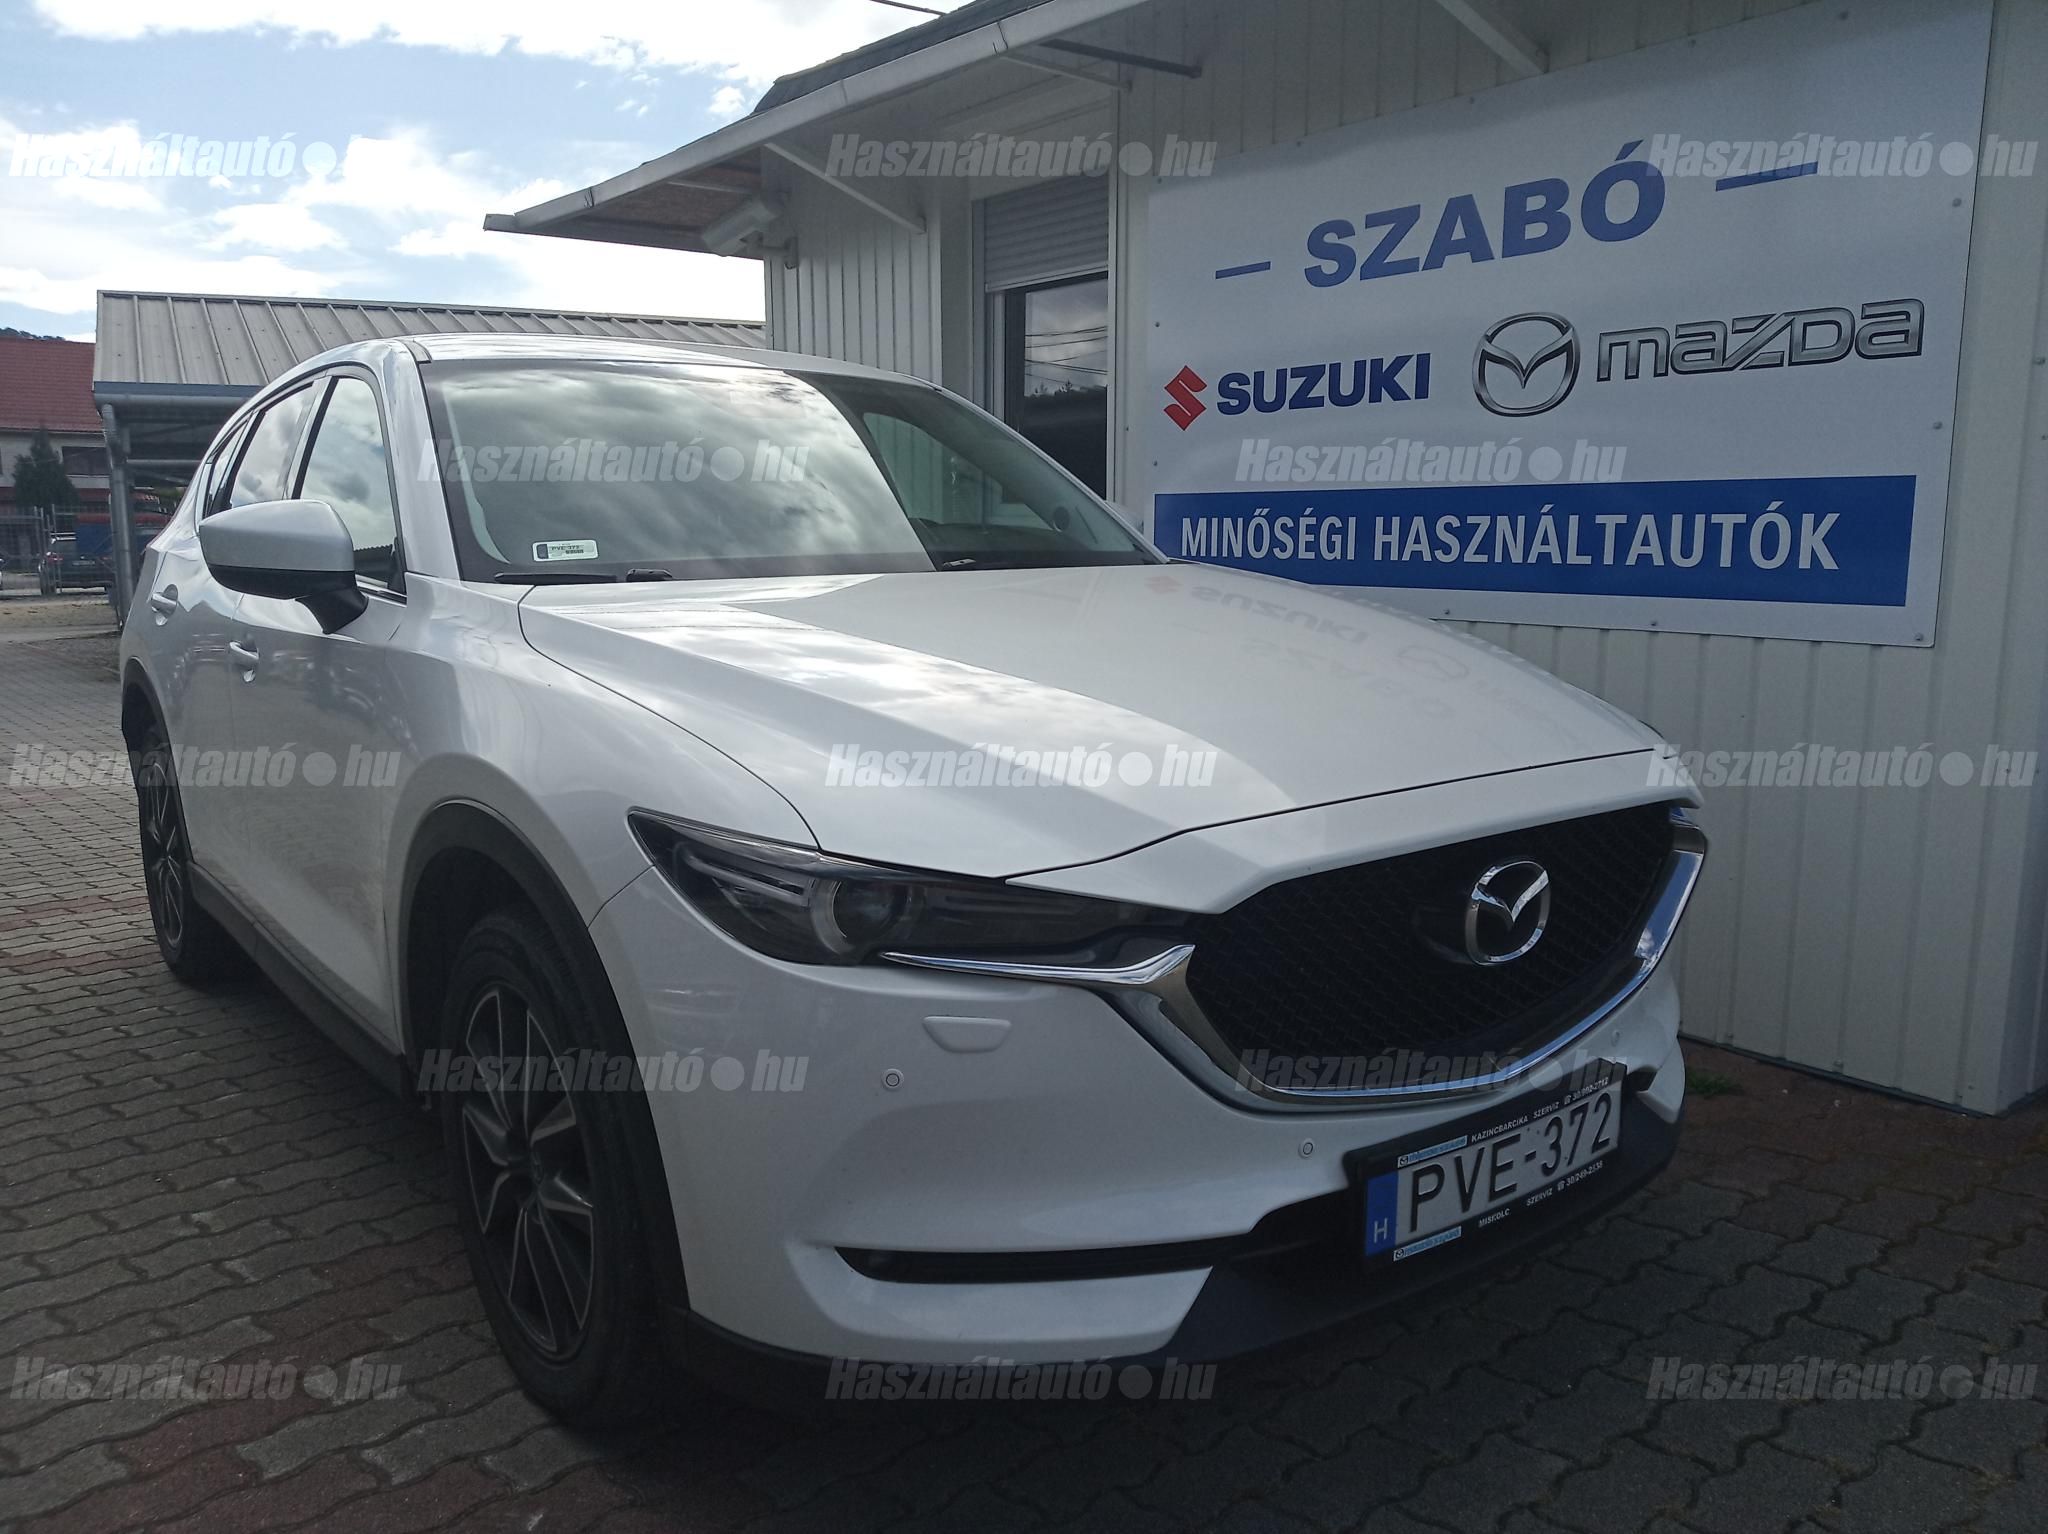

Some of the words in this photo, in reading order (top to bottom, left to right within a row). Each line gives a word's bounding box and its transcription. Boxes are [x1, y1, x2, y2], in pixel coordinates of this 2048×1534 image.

[1304, 140, 1667, 288] SZABÓ
[1217, 353, 1431, 415] SUZUKI
[1181, 506, 1356, 562] MINŐSÉGI
[1373, 501, 1840, 570] HASZNÁLTAUTÓK
[1410, 1092, 1612, 1233] PVE-372
[1372, 1218, 1389, 1244] H
